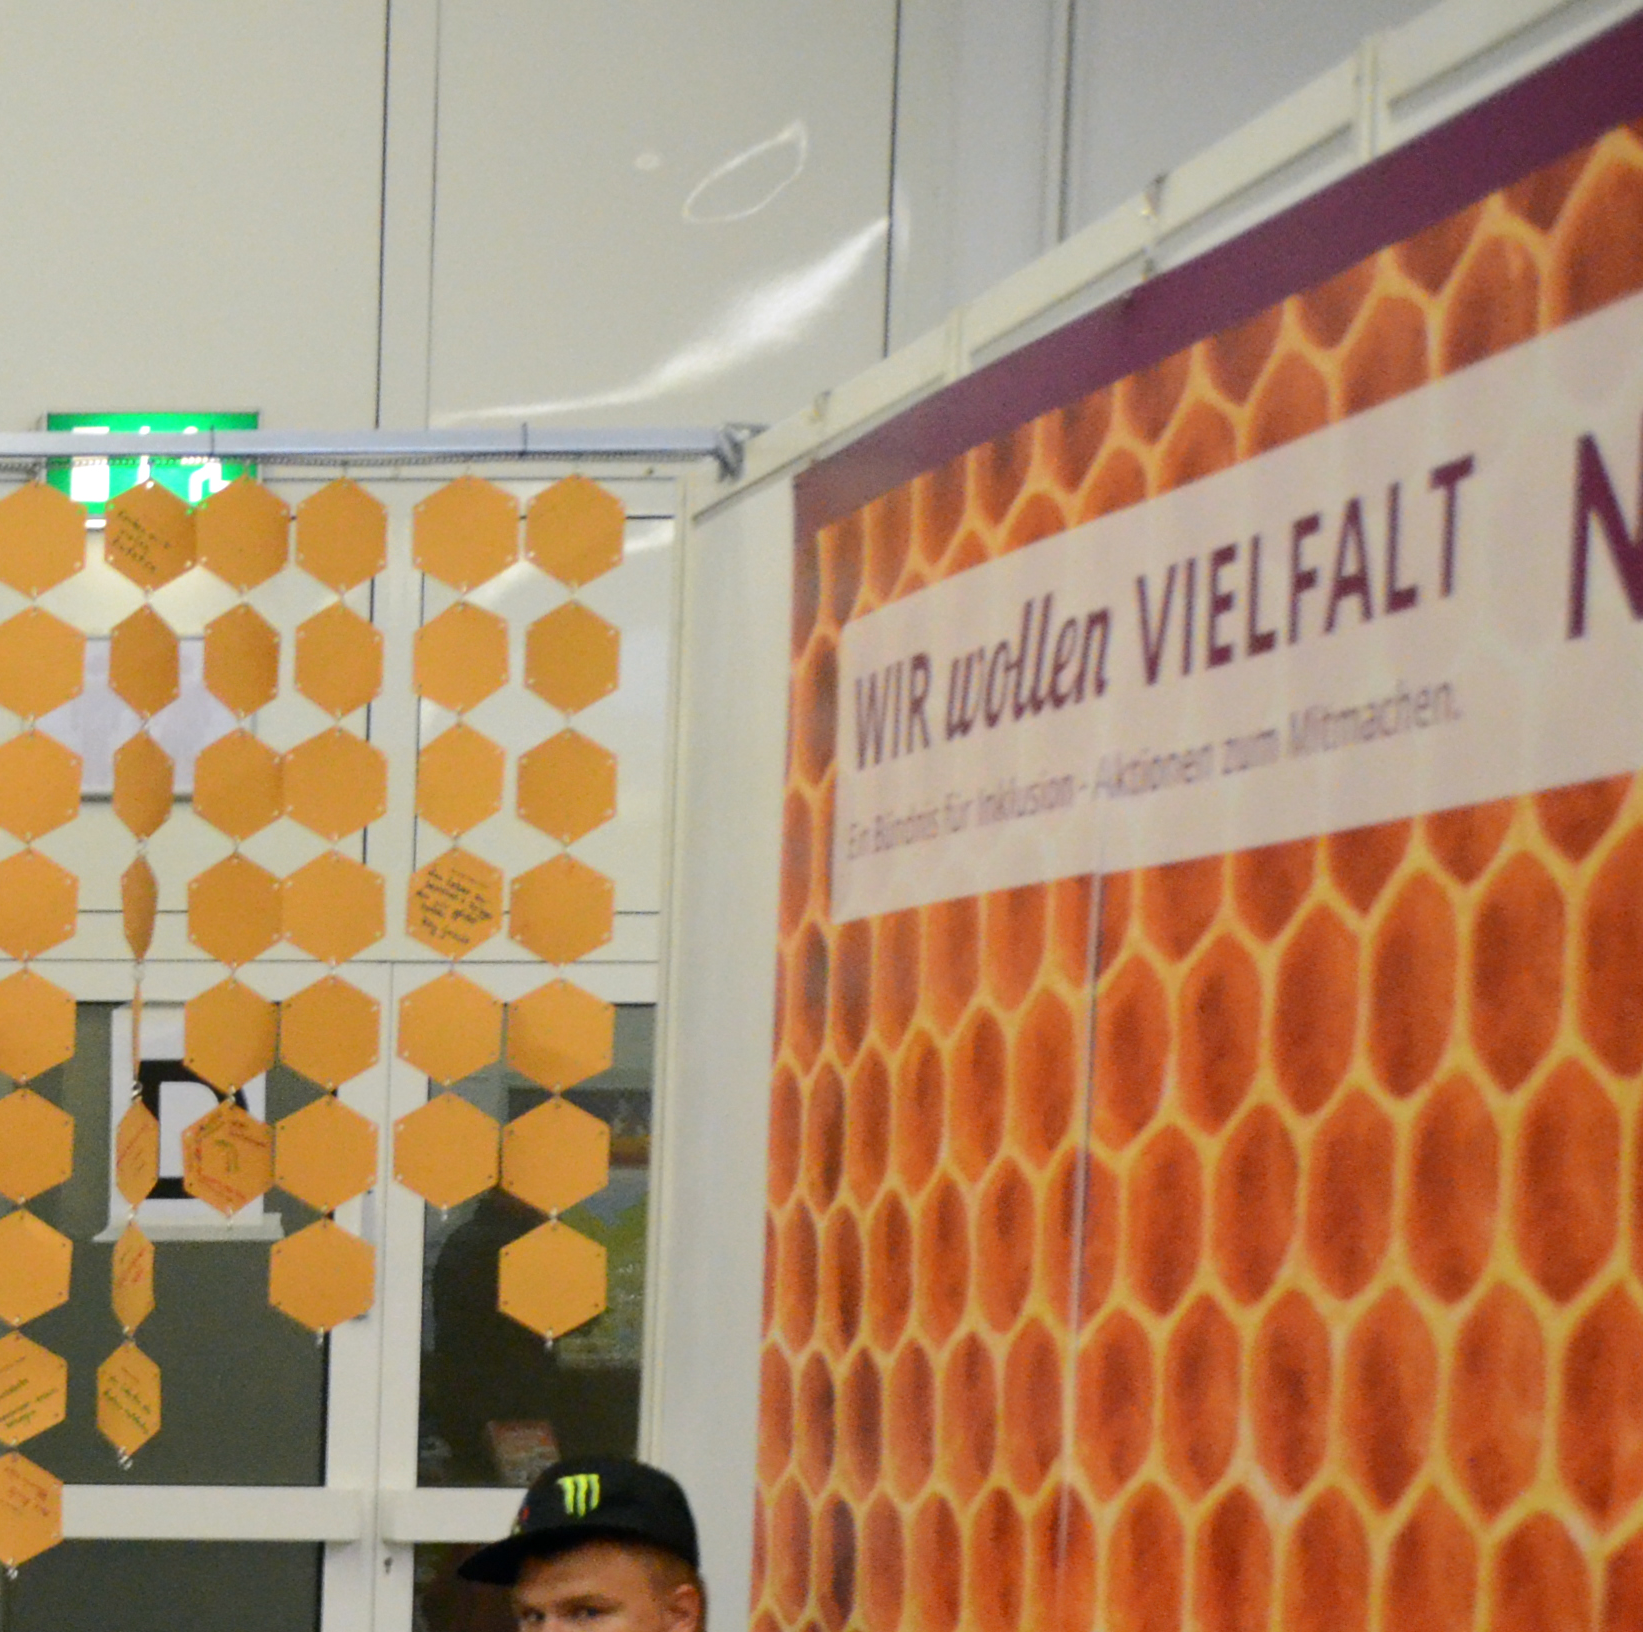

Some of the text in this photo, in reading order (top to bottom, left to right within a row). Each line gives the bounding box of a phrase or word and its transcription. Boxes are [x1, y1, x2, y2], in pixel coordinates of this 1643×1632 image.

[854, 454, 1475, 772] WIR wollen VIELFALT
[977, 773, 1075, 826] Inklusion
[1092, 744, 1215, 801] Aktionen
[1220, 727, 1281, 777] zum
[1286, 681, 1464, 758] Mitmachen.
